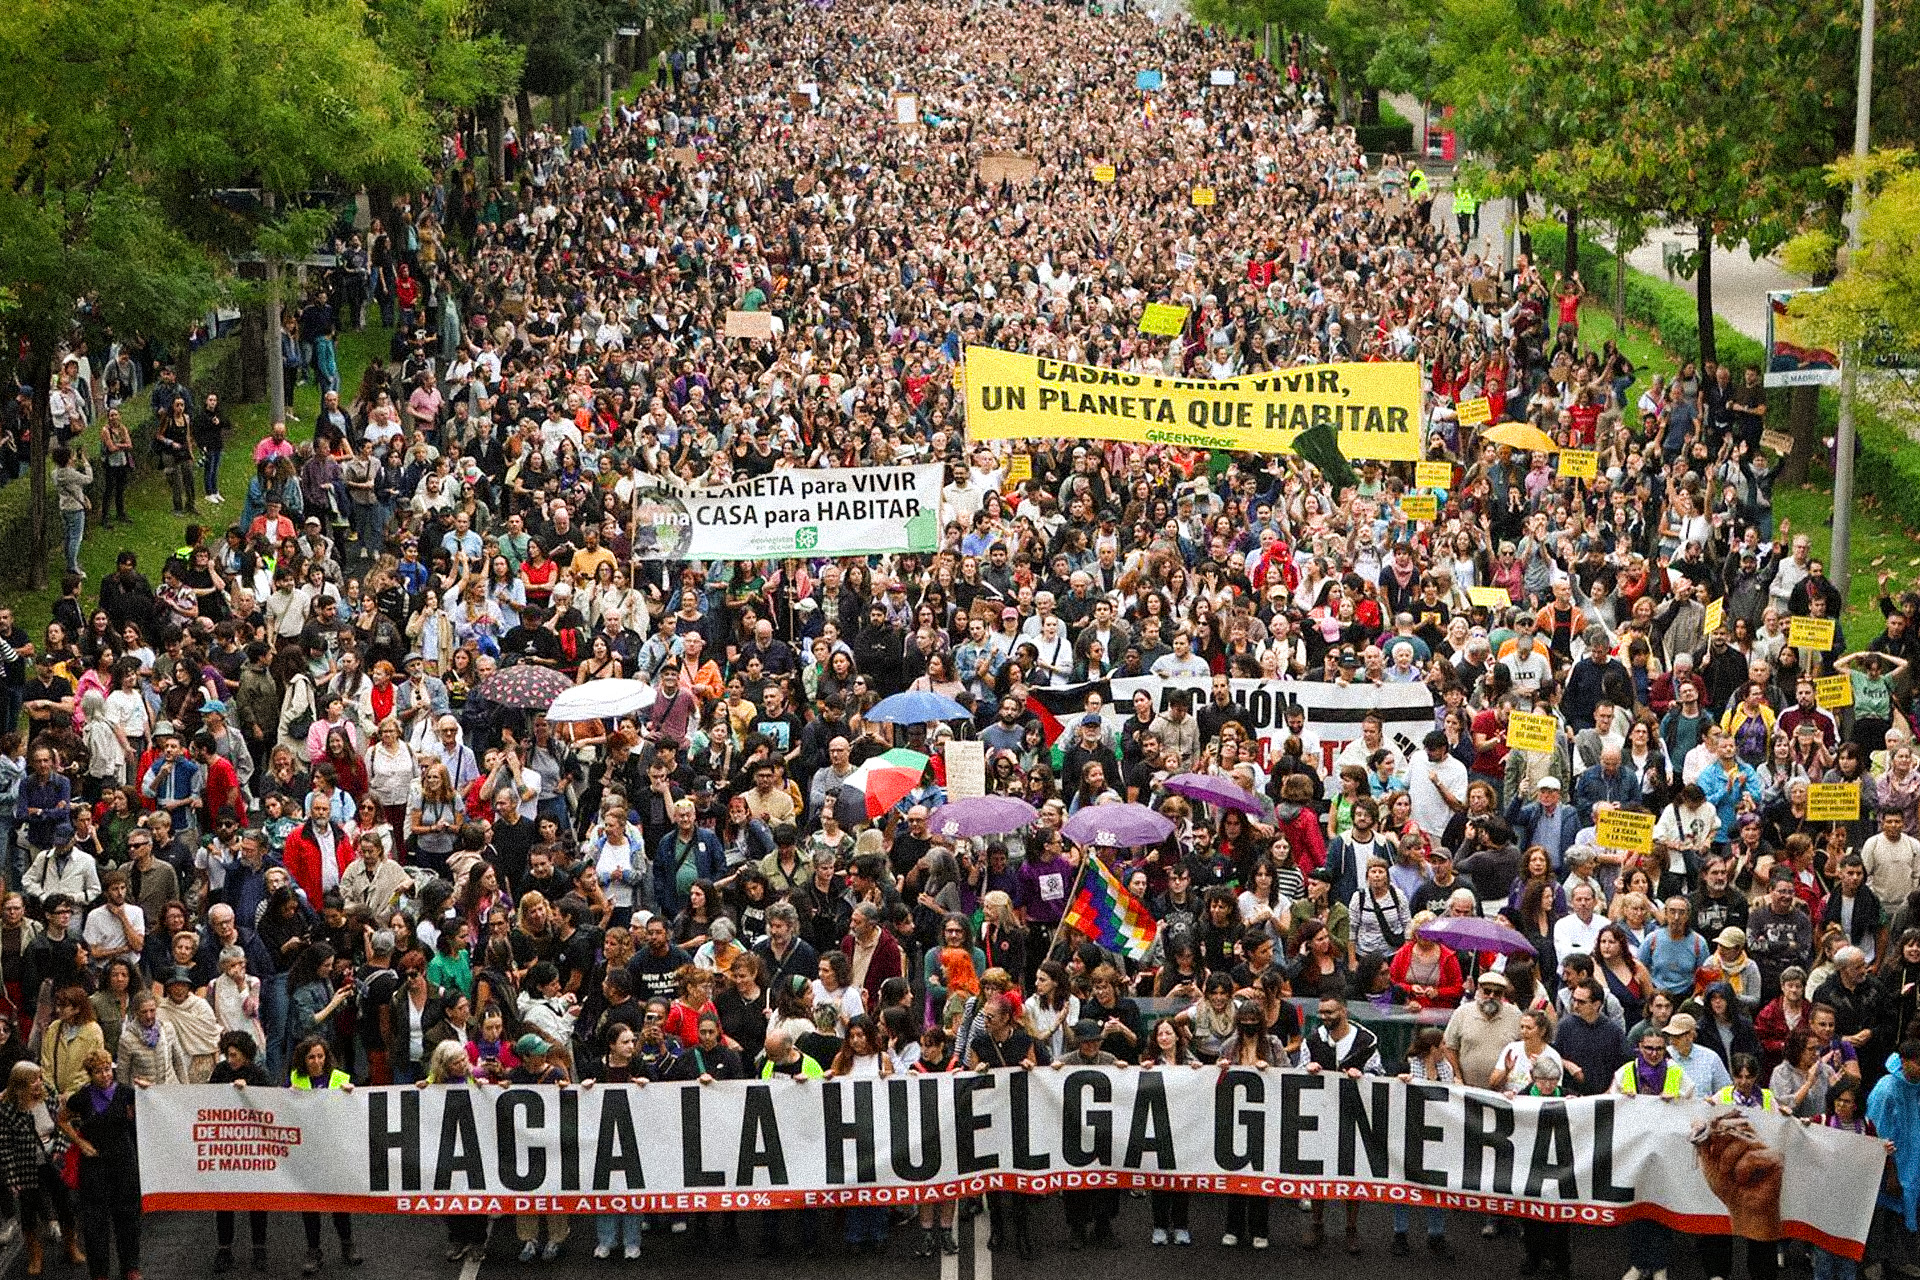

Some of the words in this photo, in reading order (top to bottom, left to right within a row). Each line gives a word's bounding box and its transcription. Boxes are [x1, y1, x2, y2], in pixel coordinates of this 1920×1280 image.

[982, 386, 1026, 411] UN
[1039, 387, 1176, 424] PLANETA
[1188, 400, 1253, 429] QUE
[1265, 402, 1409, 433] HABITAR
[1145, 430, 1235, 448] GREENPEACE
[802, 480, 847, 499] para
[852, 472, 916, 492] VIVIR
[652, 511, 690, 526] una
[696, 504, 758, 526] CASA
[764, 507, 810, 528] para
[817, 498, 920, 521] HABITAR
[197, 1109, 274, 1124] SINDICATO
[197, 1125, 215, 1138] DE
[218, 1126, 298, 1143] INQUILINAS
[368, 1088, 645, 1192] HACIA
[681, 1085, 789, 1188] LA
[822, 1069, 1177, 1184] HUELGA
[1214, 1069, 1635, 1201] GENERAL
[197, 1145, 207, 1156] E
[208, 1144, 290, 1158] INQUILINOS
[197, 1159, 216, 1172] DE
[218, 1159, 277, 1172] MADRID
[397, 1197, 502, 1212] BAJADA
[515, 1197, 565, 1212] DEL
[576, 1195, 708, 1212] ALQUILER
[720, 1193, 772, 1208] 50%
[805, 1171, 1004, 1206] EXPROPIACIÓN
[1016, 1171, 1119, 1191] FONDOS
[1131, 1173, 1228, 1191] BUITRE
[1261, 1179, 1424, 1203] CONTRATOS
[1435, 1193, 1617, 1224] INDEFINIDOS
